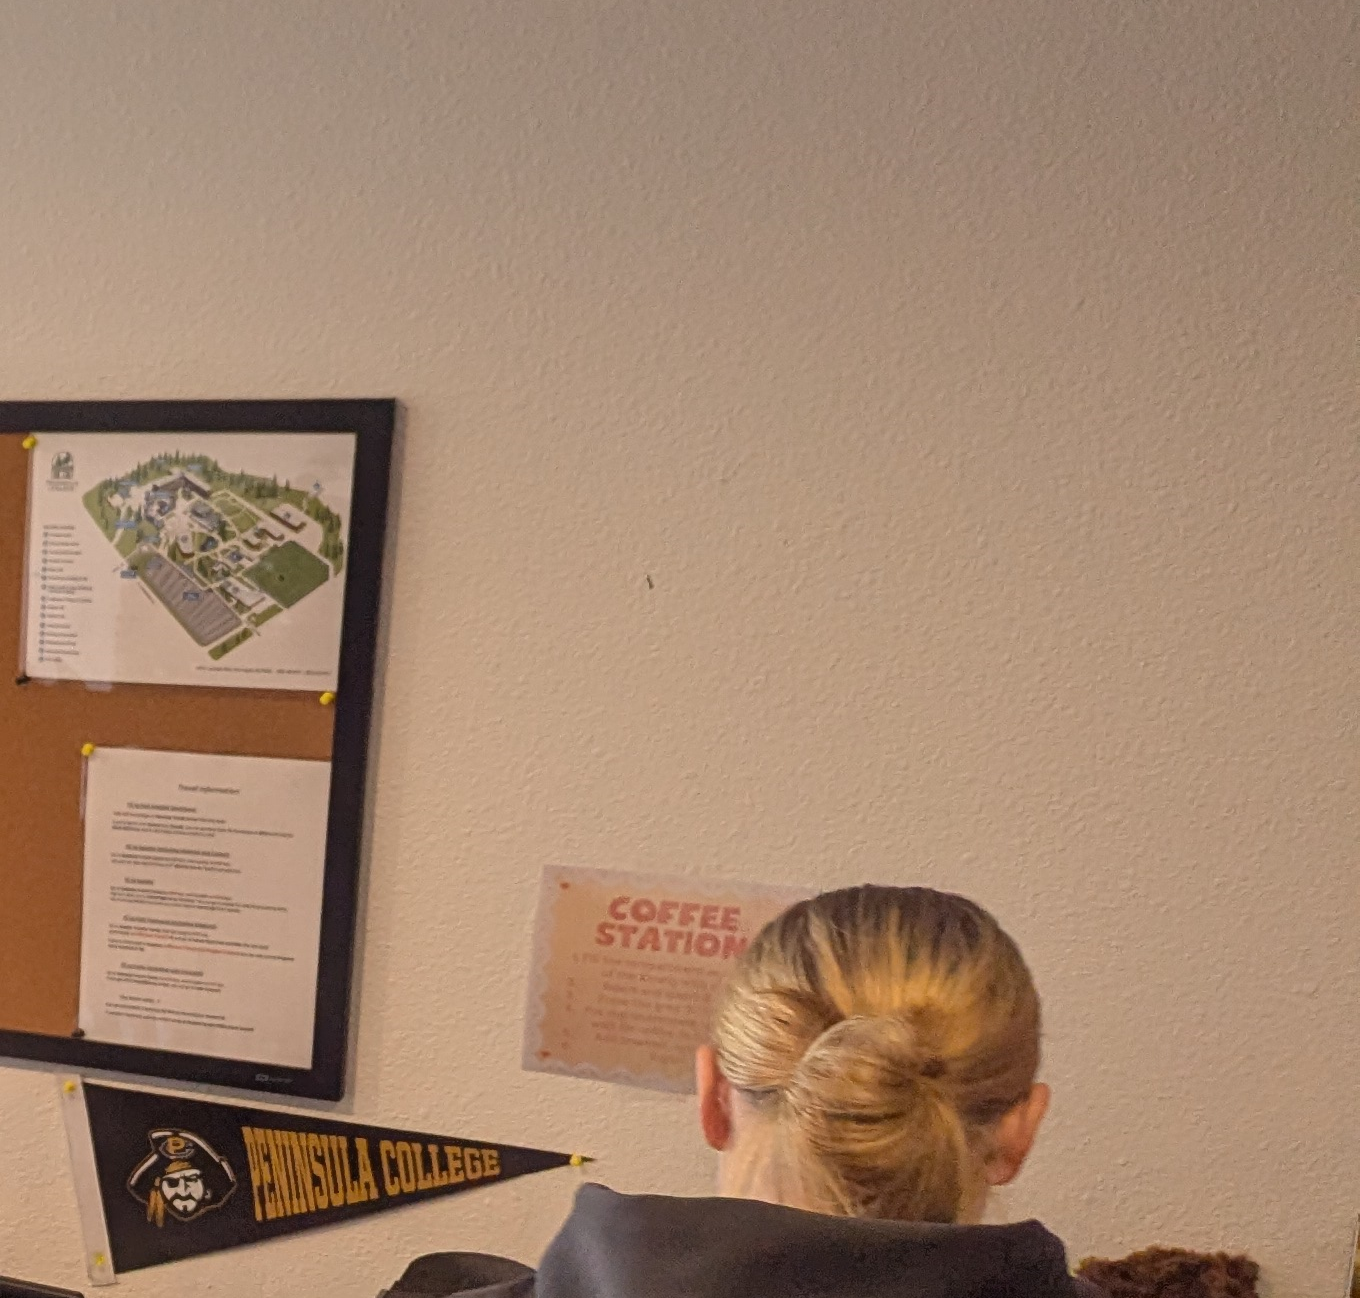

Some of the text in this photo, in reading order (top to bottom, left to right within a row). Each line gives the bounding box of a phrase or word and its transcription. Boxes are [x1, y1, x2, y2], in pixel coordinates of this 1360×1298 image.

[608, 896, 742, 931] COFFEE
[594, 921, 748, 959] STATION
[241, 1126, 502, 1223] PENINSULA COLLEGE
